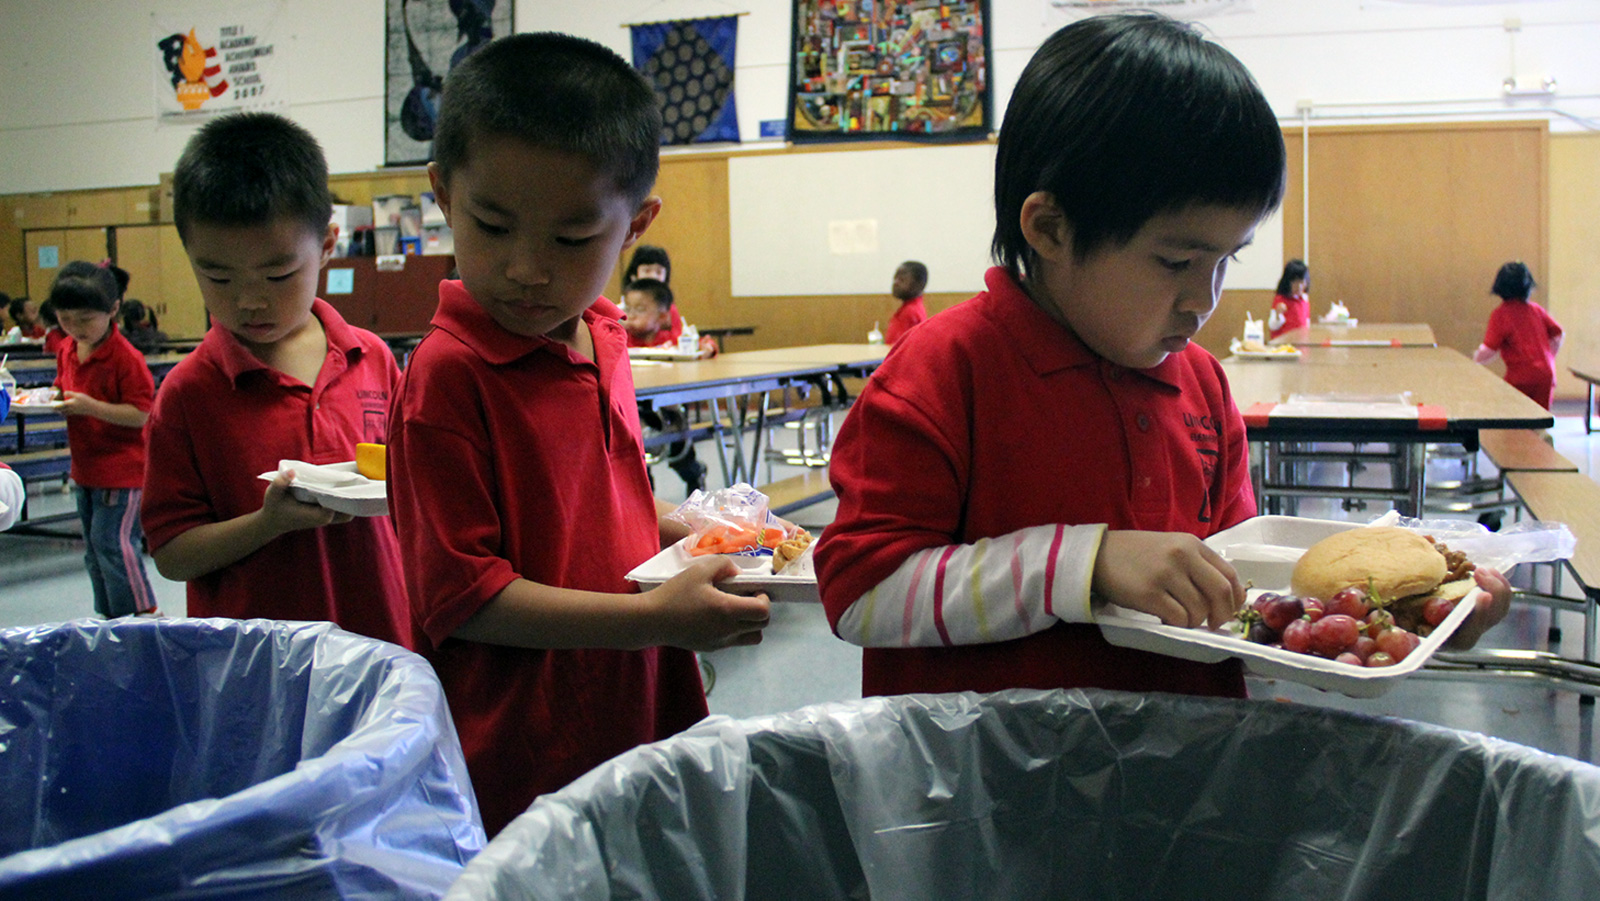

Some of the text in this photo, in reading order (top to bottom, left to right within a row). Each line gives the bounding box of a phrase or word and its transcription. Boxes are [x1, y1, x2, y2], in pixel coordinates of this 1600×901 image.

[220, 26, 238, 36] TITLE
[229, 62, 256, 74] AWARD
[233, 74, 261, 86] SCHOOL
